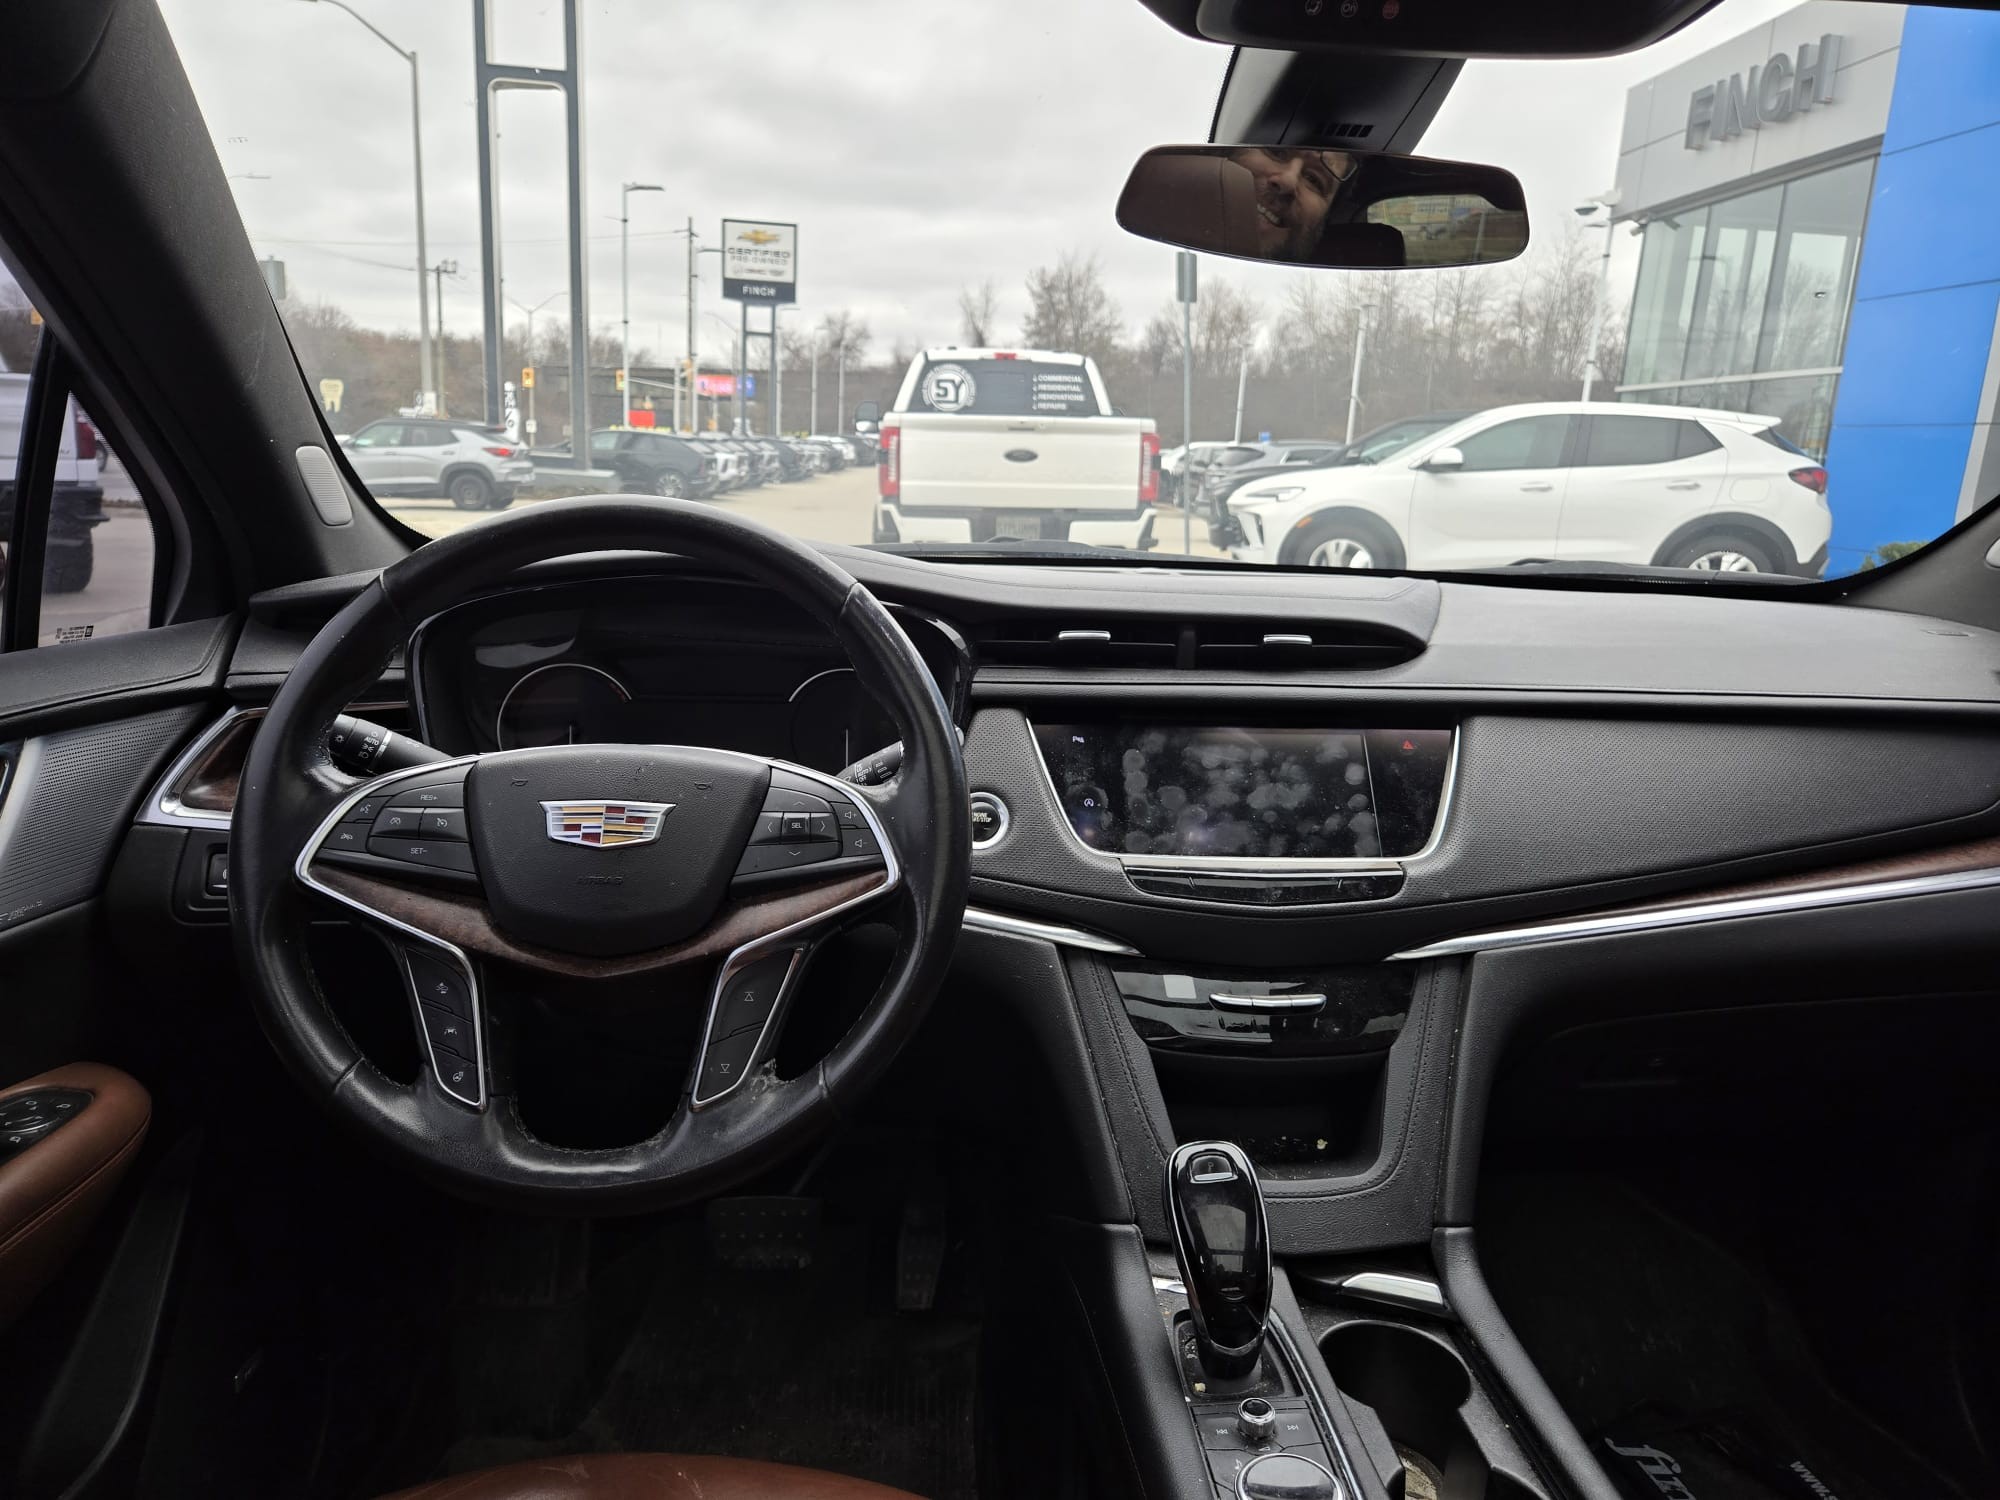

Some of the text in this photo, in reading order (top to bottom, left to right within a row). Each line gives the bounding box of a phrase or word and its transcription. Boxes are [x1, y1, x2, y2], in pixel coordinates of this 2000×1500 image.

[1684, 33, 1842, 152] FINCH
[728, 247, 791, 258] CERTIFIED
[742, 285, 777, 296] FINCH
[1037, 374, 1083, 383] COMMERCIAL
[1037, 384, 1081, 392] RESIDENTIAL
[1037, 393, 1085, 401] RENOVATIONS
[1037, 402, 1067, 410] REPAIRS
[364, 736, 380, 746] AUTO
